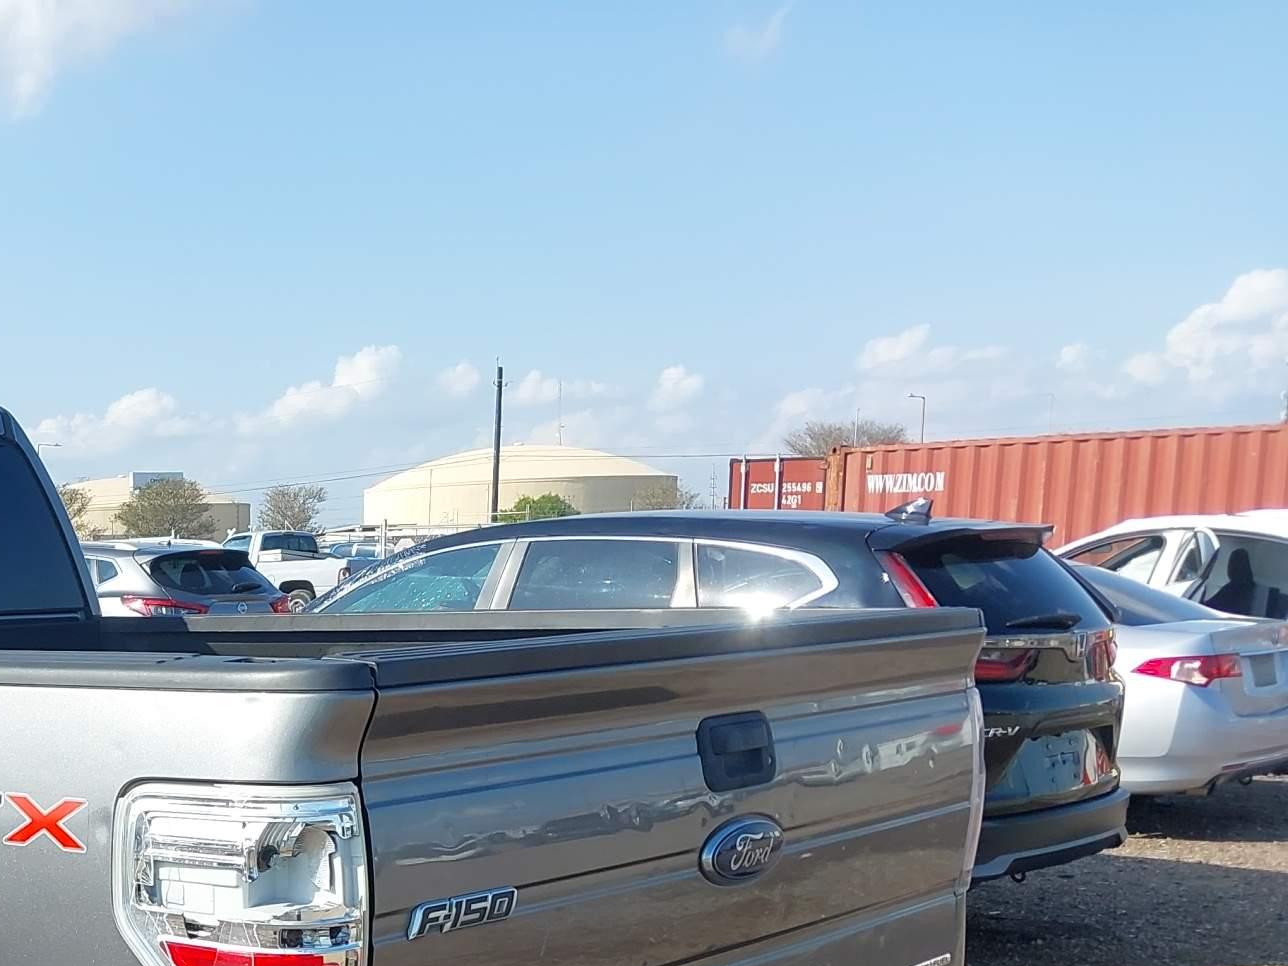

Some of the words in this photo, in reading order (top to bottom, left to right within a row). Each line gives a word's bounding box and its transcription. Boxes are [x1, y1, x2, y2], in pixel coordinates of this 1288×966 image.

[750, 482, 774, 493] ZCSU
[730, 832, 775, 871] Ford
[407, 887, 518, 941] F-150
